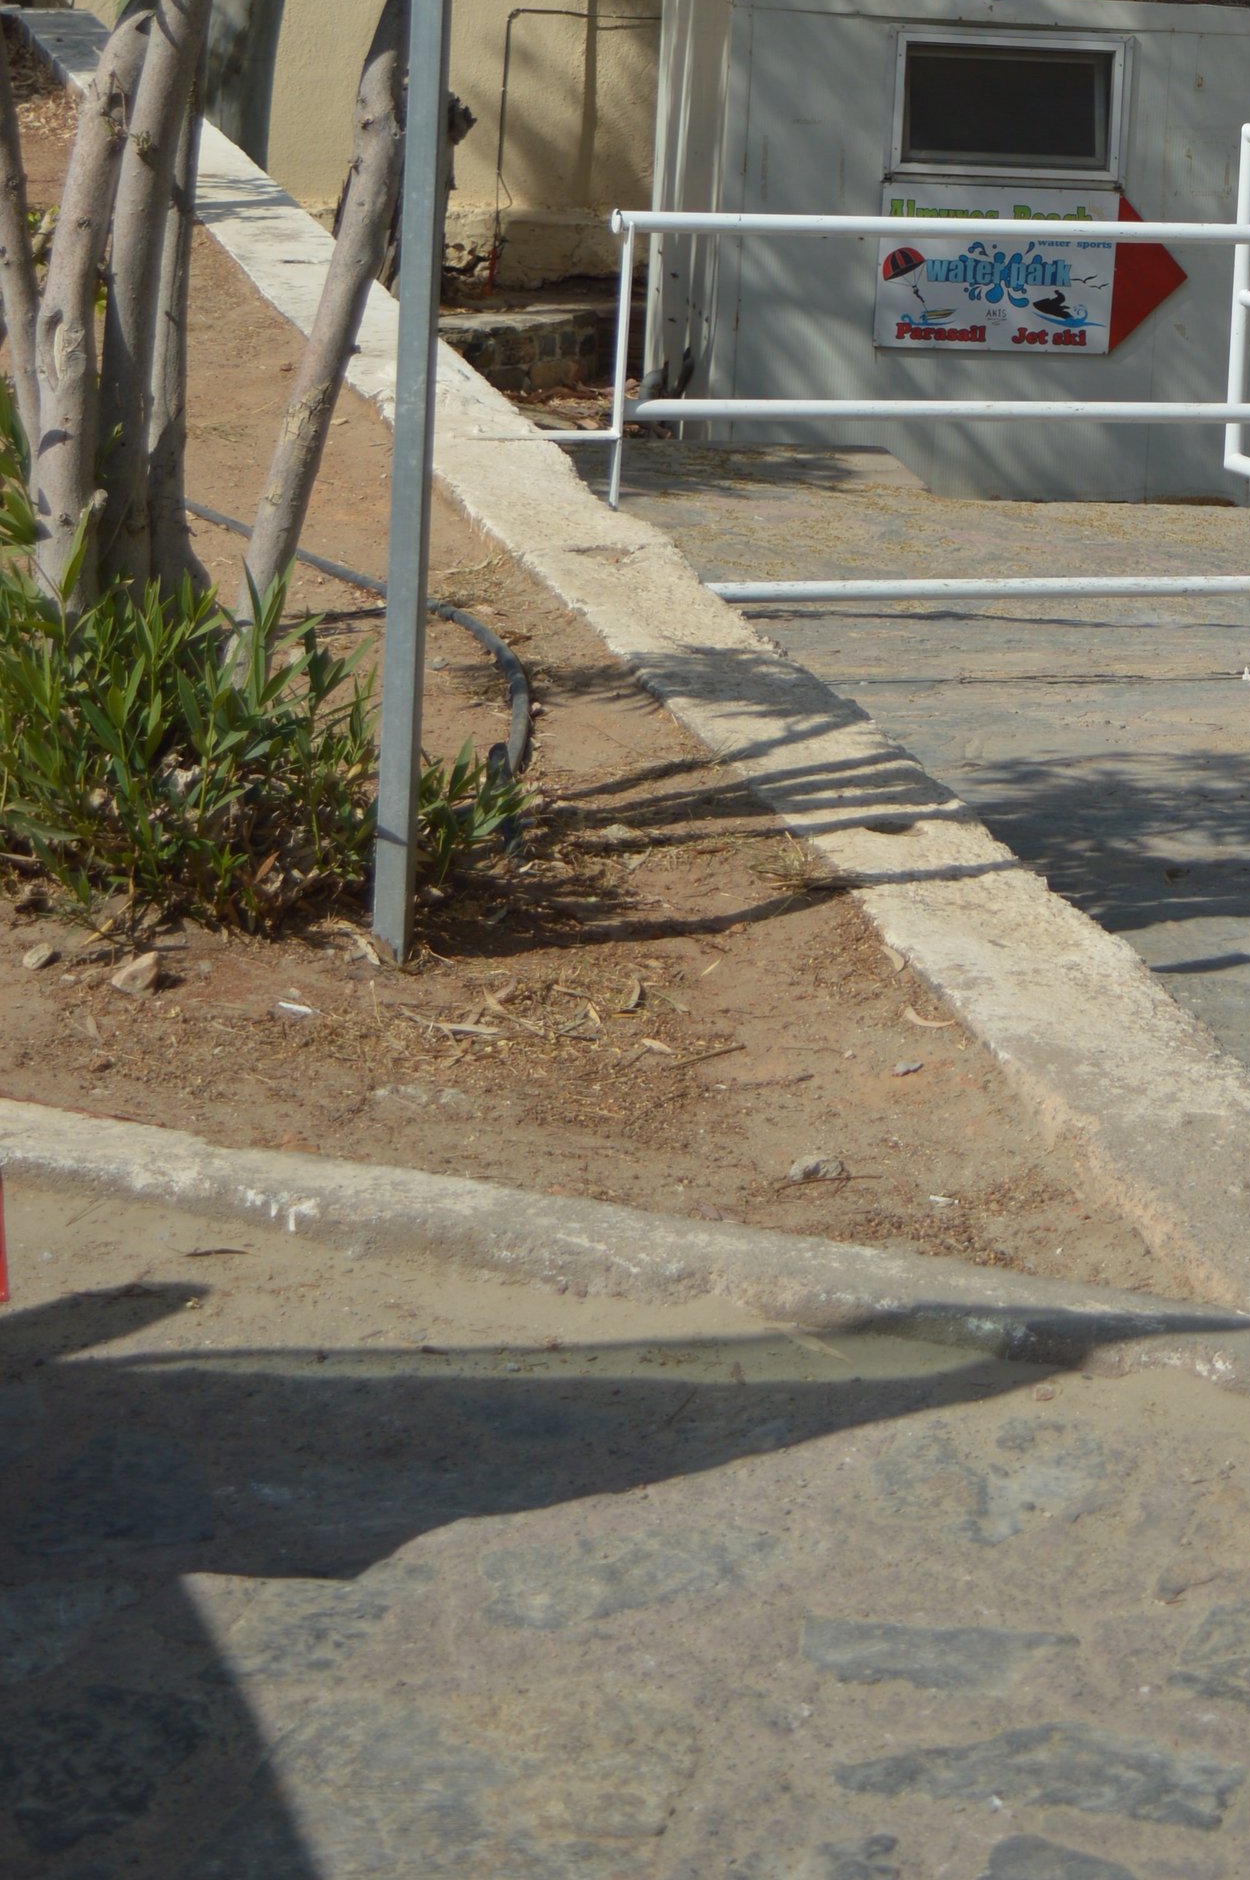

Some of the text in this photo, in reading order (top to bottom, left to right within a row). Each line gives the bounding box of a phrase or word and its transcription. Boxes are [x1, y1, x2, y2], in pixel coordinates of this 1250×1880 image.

[1037, 240, 1113, 250] water sports
[926, 258, 1072, 288] water park
[895, 322, 987, 343] Parasail
[1011, 327, 1087, 346] Jet ski
